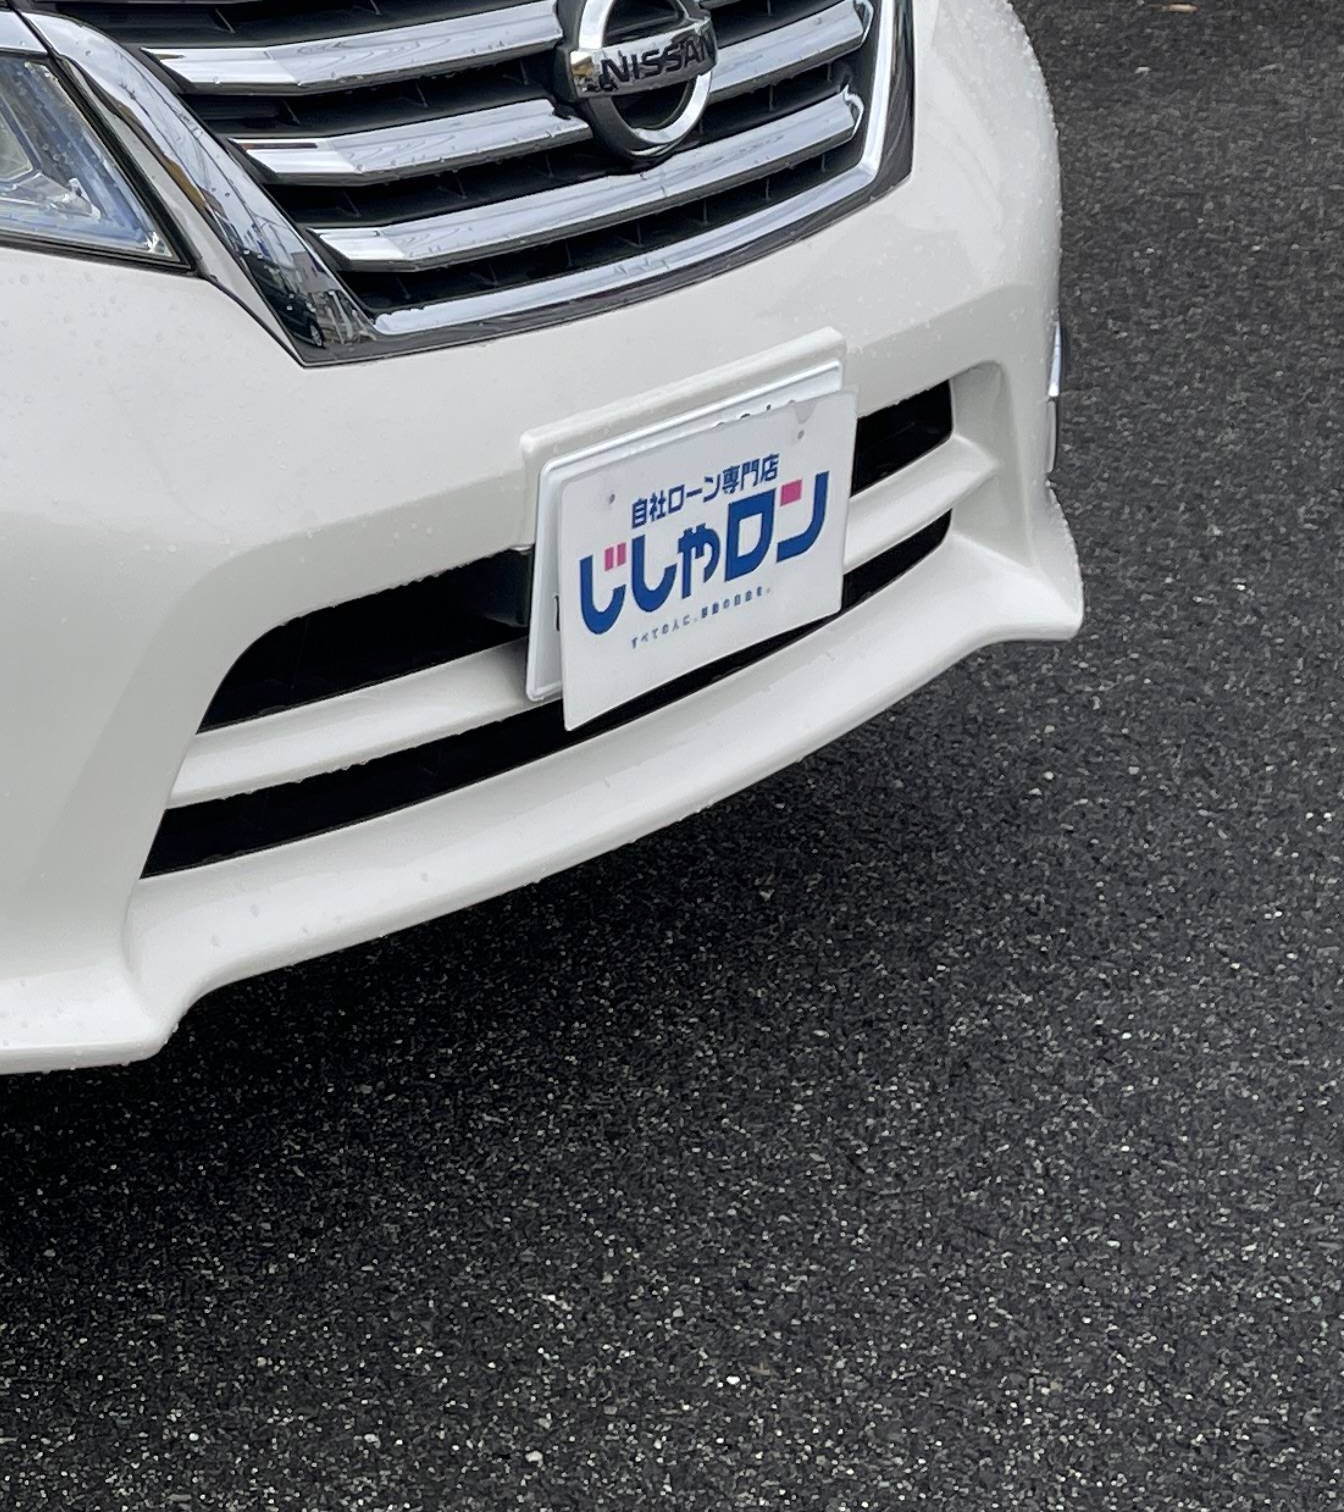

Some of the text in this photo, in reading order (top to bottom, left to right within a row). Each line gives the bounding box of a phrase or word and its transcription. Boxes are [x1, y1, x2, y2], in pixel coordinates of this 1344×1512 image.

[600, 30, 716, 83] NISSAN
[631, 452, 780, 530] 自社ローン専門店
[579, 471, 830, 635] じしゃロン
